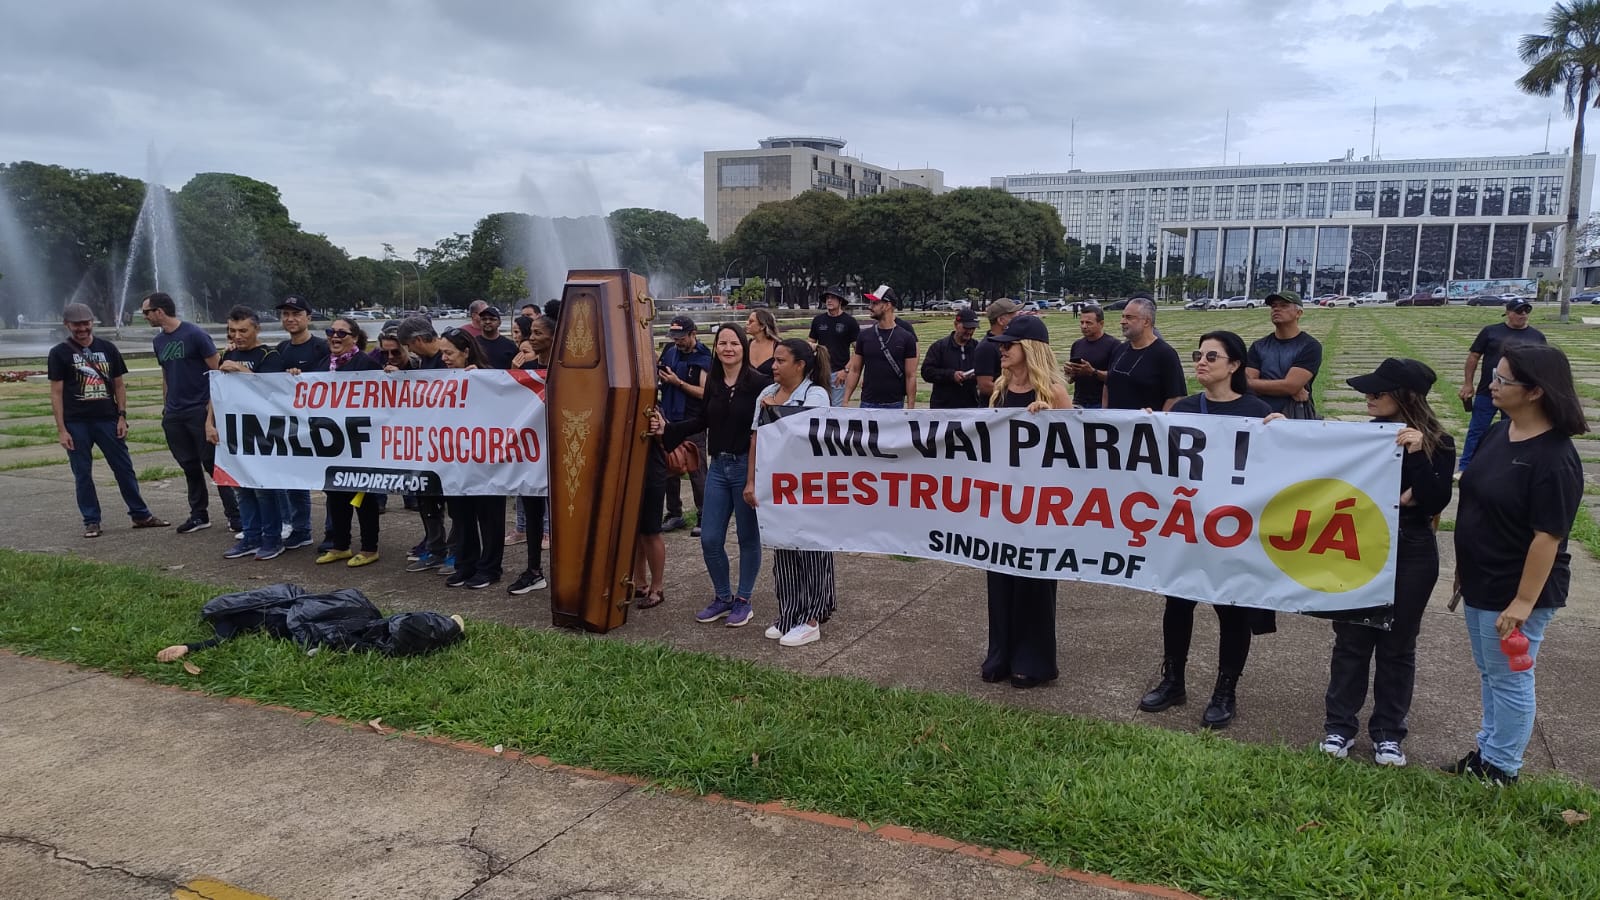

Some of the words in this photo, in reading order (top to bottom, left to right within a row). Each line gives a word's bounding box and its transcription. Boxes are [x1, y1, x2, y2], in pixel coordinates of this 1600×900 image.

[293, 379, 468, 409] GOVERNADOR!
[225, 413, 371, 458] IMLDF
[381, 425, 423, 461] PEDE
[428, 426, 541, 464] SOCORRO
[808, 418, 898, 459] IML
[908, 420, 991, 463] VAI
[1009, 419, 1207, 481] PARAR
[333, 471, 428, 492] SINDIRETA-DF
[772, 471, 1253, 548] REESTRUTURAÇÃO
[1269, 497, 1361, 561] JÁ
[928, 530, 1146, 579] SINDIRETA-DF
